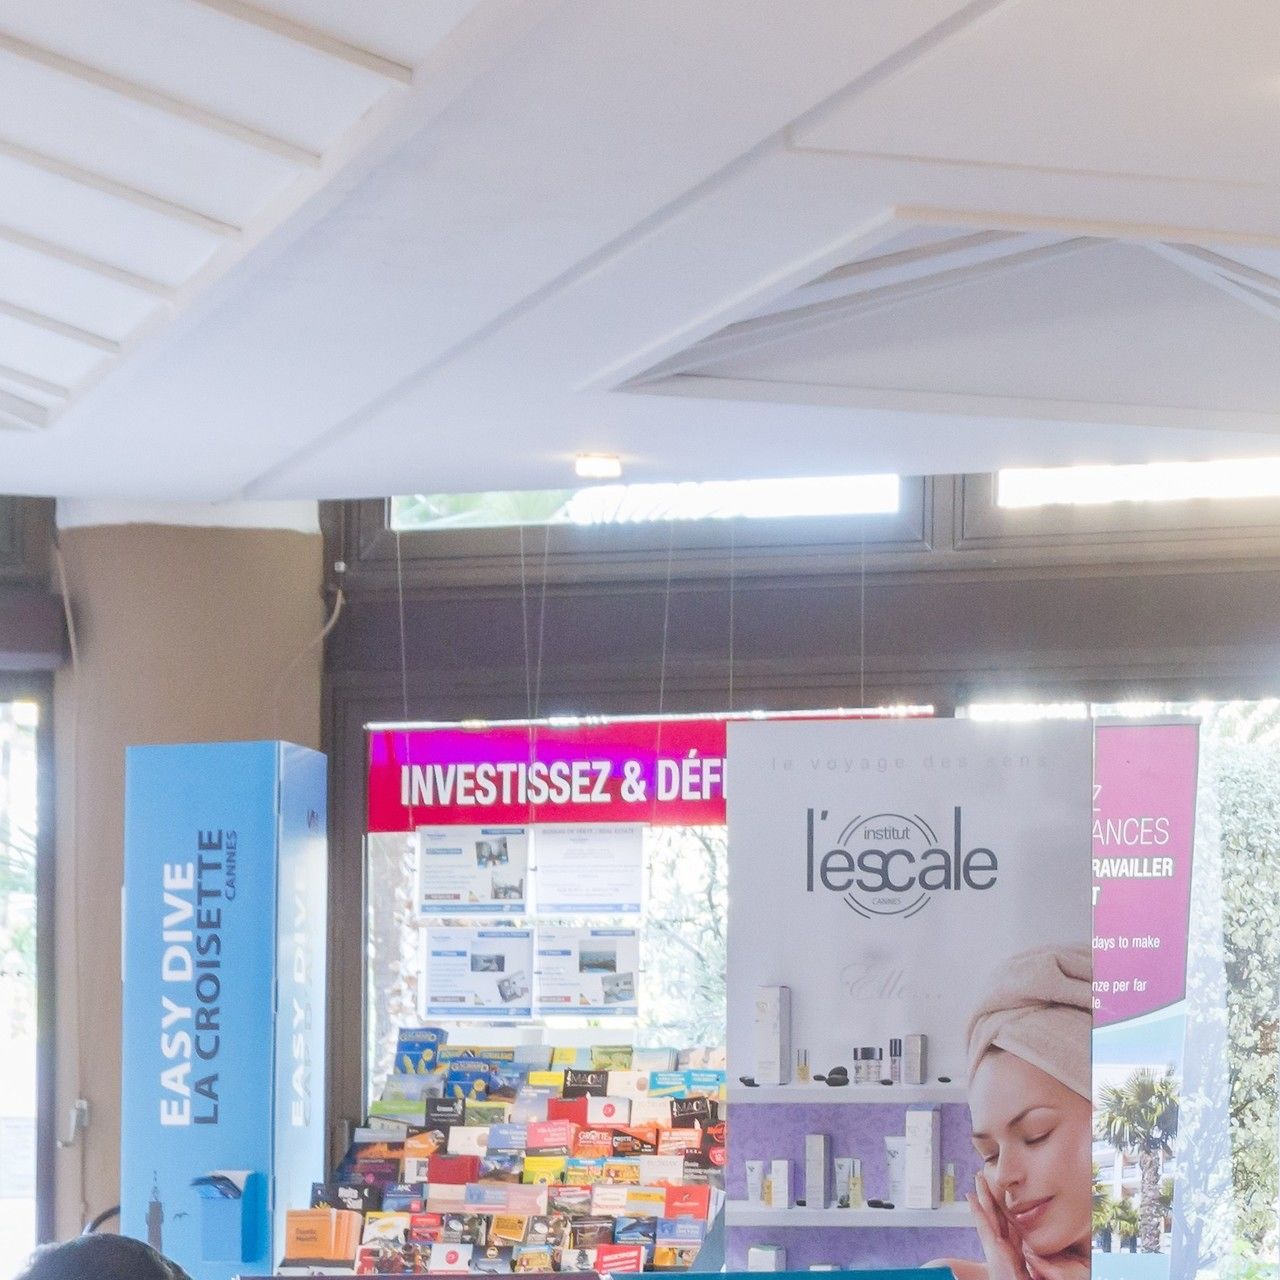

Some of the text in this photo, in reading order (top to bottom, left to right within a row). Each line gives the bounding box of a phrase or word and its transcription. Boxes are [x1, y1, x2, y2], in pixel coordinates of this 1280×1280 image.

[400, 759, 612, 807] INVESTISSEZ
[620, 759, 647, 804] &
[224, 830, 238, 901] CANNES
[806, 805, 998, 892] l'escale
[863, 824, 911, 841] institut
[194, 829, 223, 1125] LA CROISETTE
[1092, 935, 1161, 950] days to make
[160, 862, 195, 1126] EASY DIVE
[1112, 980, 1130, 993] per
[1133, 977, 1147, 991] far
[291, 997, 306, 1127] EASY
